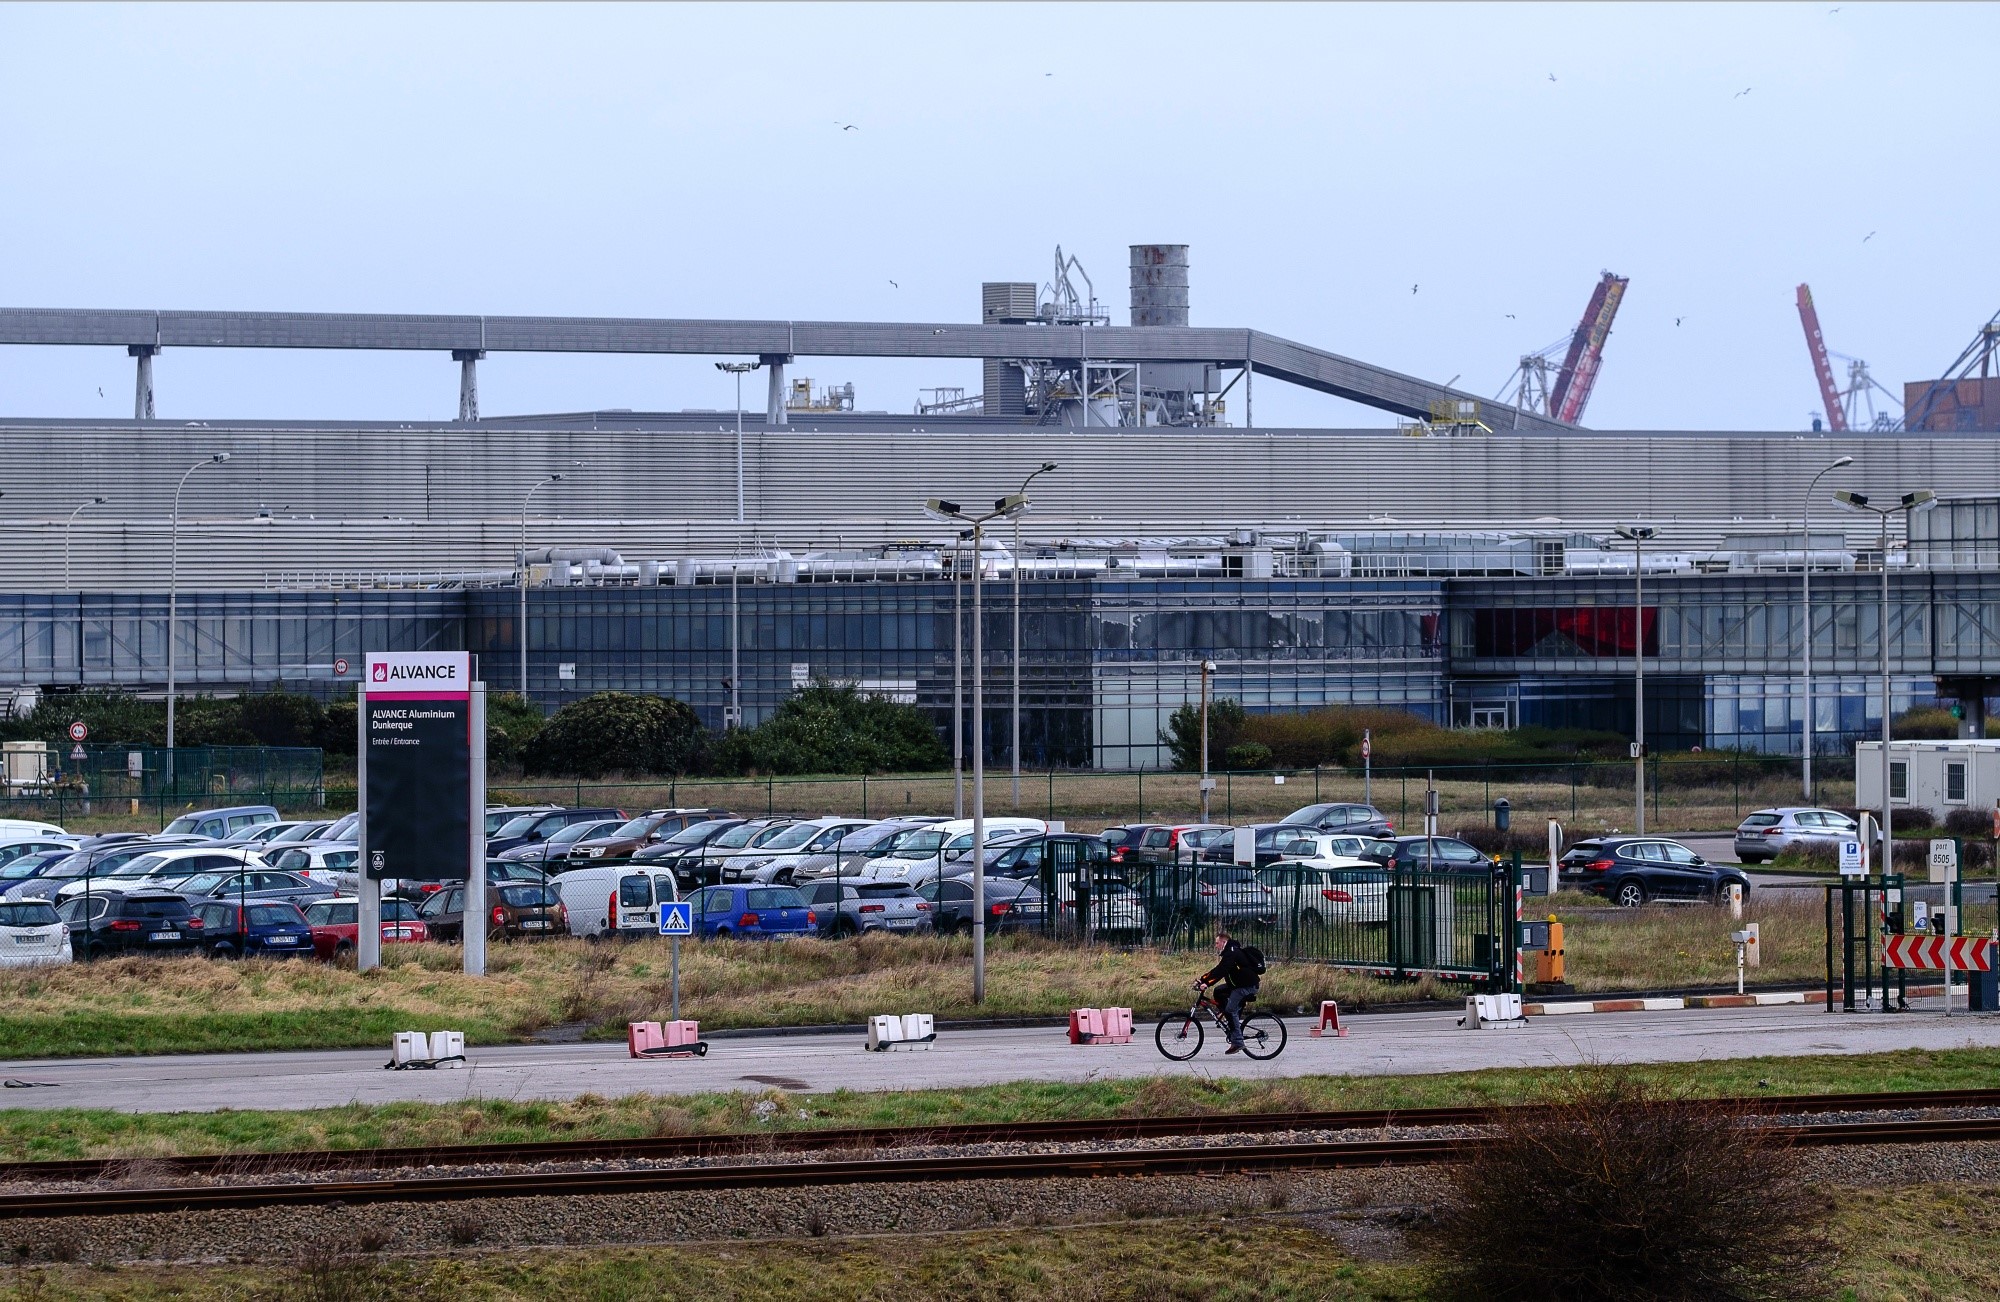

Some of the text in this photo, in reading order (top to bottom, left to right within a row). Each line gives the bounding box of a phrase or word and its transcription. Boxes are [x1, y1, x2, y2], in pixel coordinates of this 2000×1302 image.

[390, 665, 455, 679] ALVANCE
[372, 709, 455, 719] ALVANCE Aluminium
[372, 720, 413, 731] Dunkerque
[372, 737, 389, 745] Entrée
[394, 737, 420, 745] Entrance
[1631, 743, 1638, 757] Y
[1849, 844, 1855, 853] P
[1933, 854, 1950, 863] 8505
